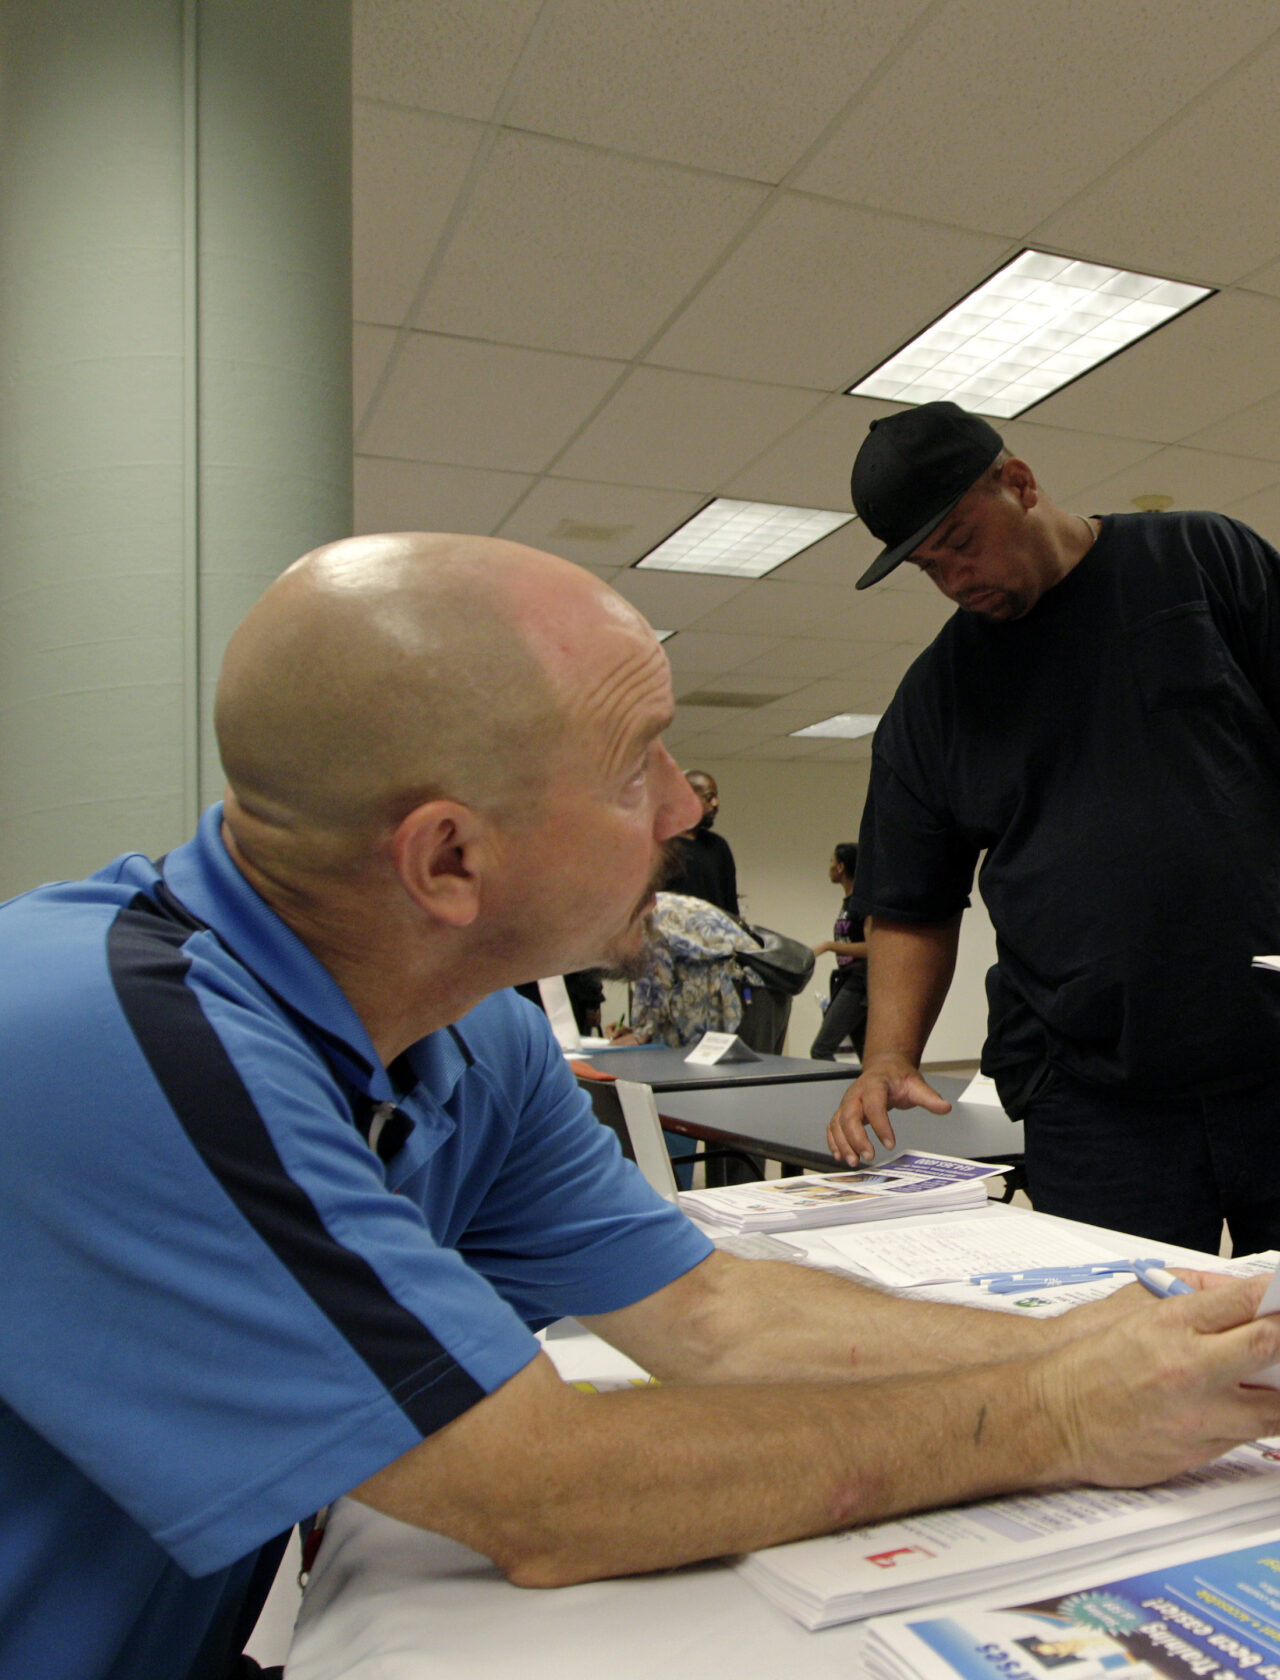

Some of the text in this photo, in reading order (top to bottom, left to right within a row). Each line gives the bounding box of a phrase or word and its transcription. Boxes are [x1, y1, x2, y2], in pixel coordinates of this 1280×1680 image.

[1143, 1598, 1212, 1635] easier!
[1140, 1621, 1219, 1677] Training
[1208, 1634, 1262, 1668] been
